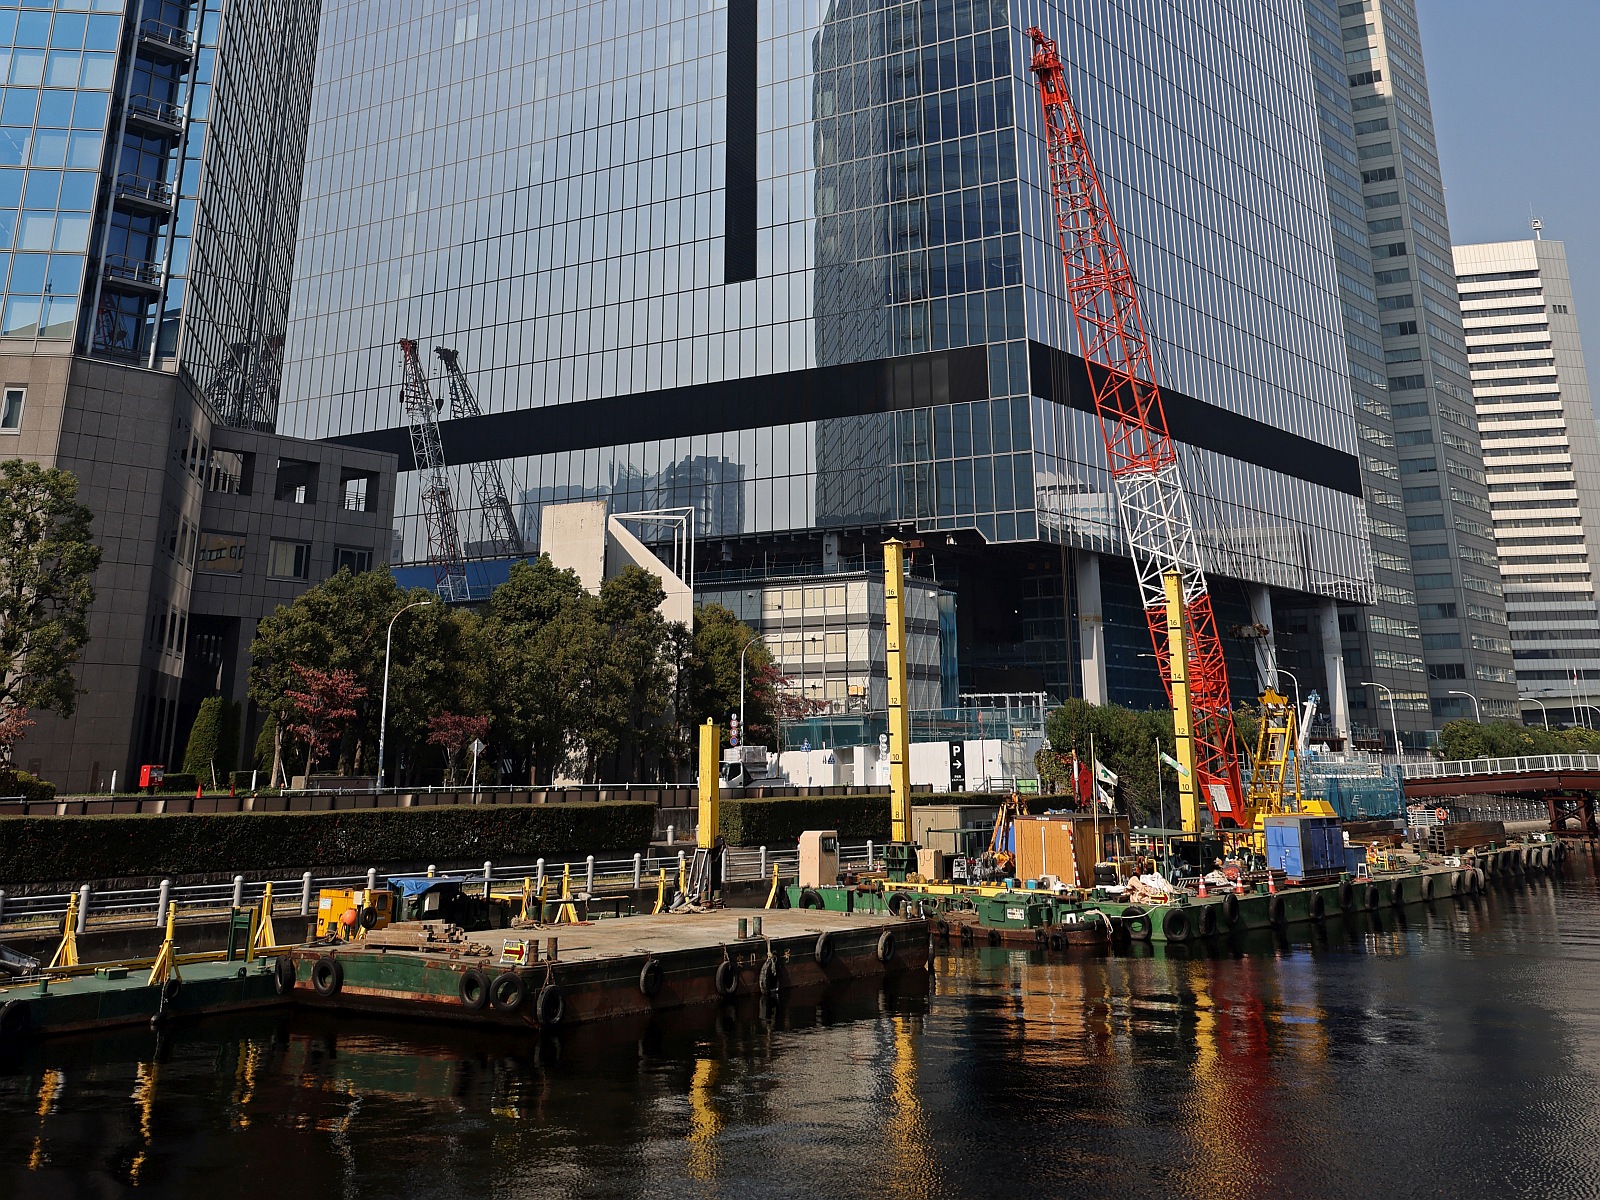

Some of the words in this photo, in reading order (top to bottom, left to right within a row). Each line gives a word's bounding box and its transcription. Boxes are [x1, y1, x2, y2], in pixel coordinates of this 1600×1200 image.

[887, 588, 895, 596] 16
[890, 697, 898, 705] 12
[1177, 727, 1186, 735] 12
[952, 745, 961, 757] P
[892, 753, 900, 761] 10
[1181, 783, 1190, 791] 10
